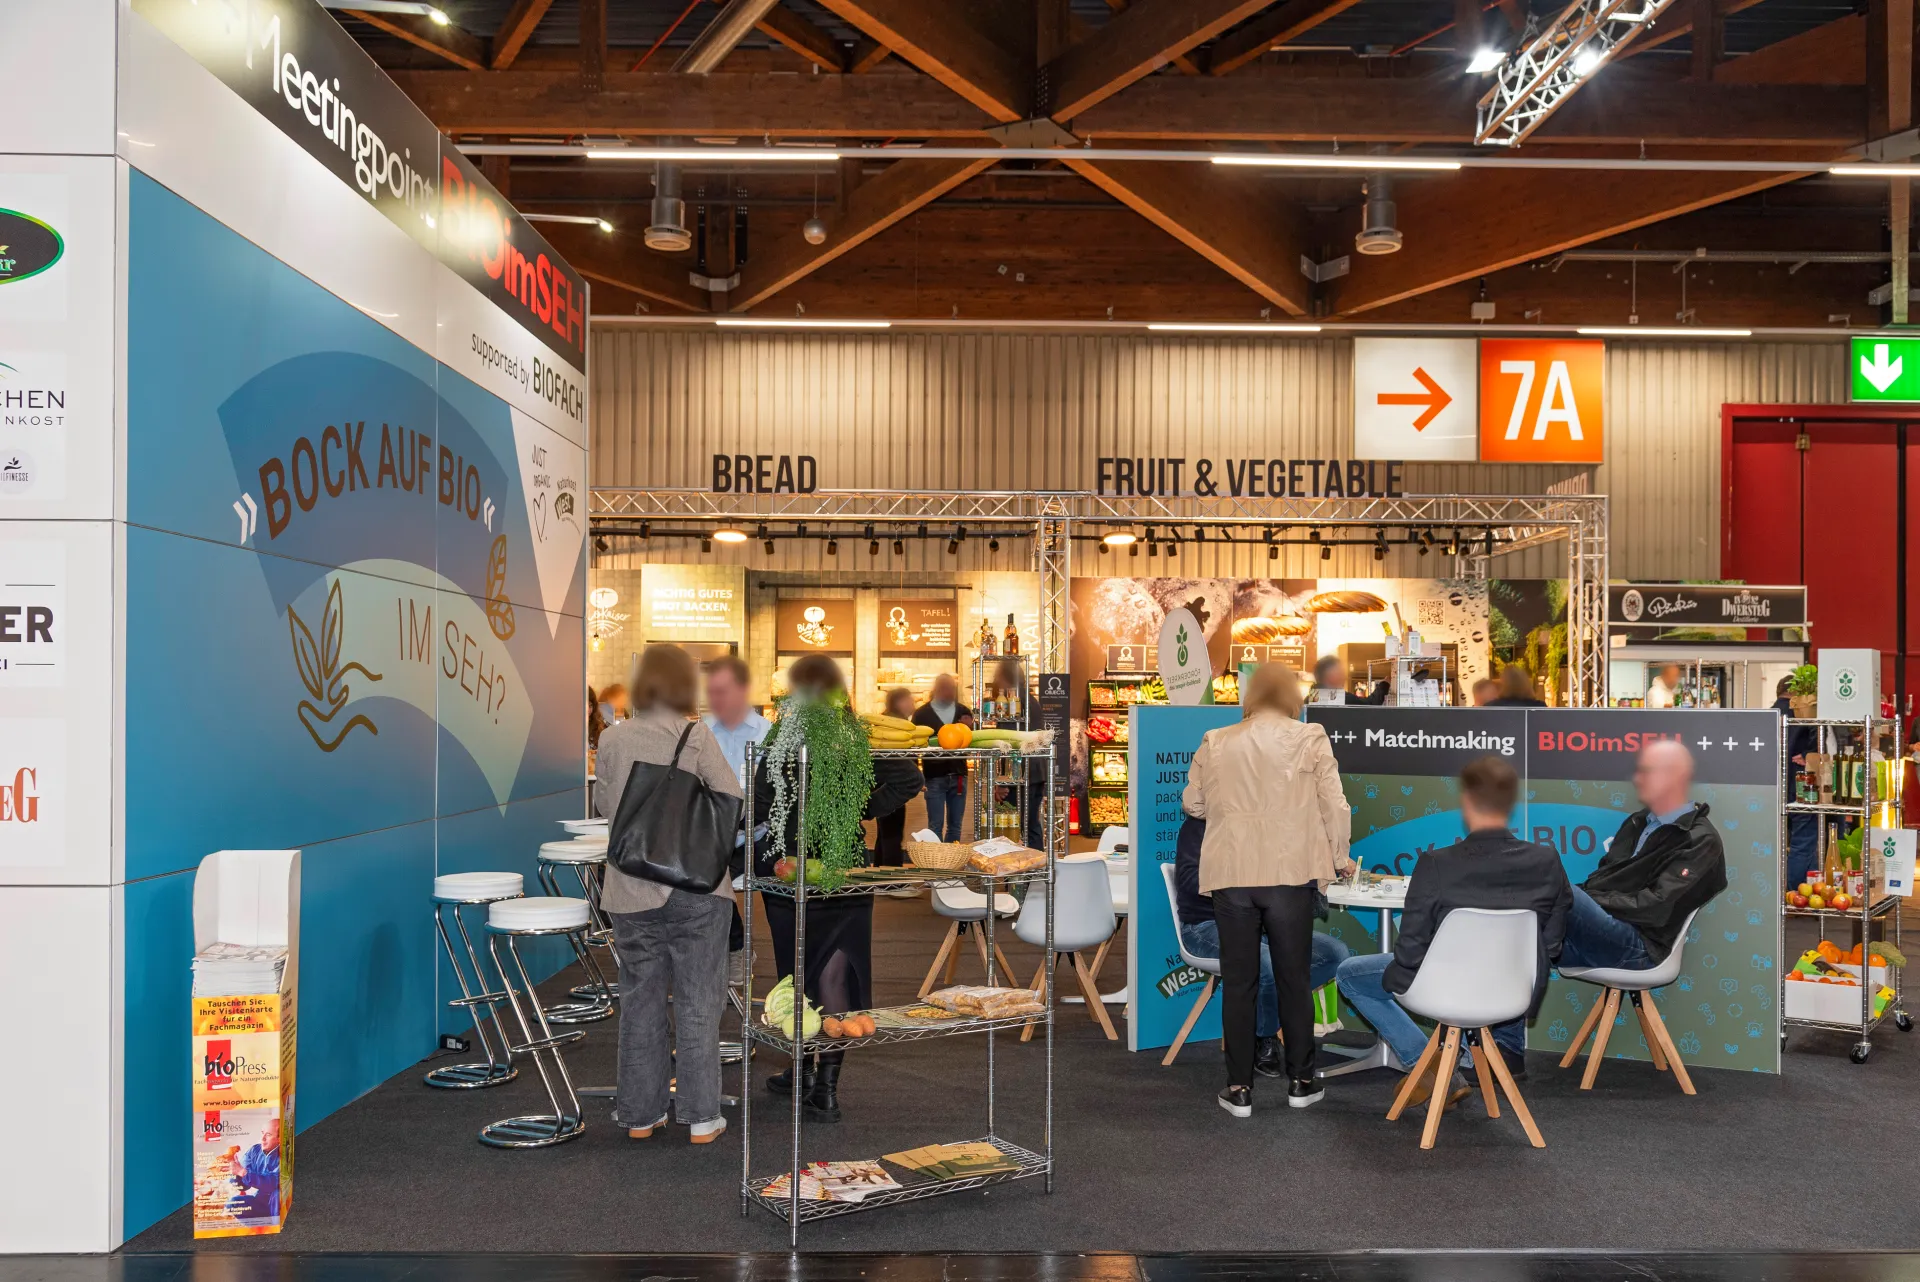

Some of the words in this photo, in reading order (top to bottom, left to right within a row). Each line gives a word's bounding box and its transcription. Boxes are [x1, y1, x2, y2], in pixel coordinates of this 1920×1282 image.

[246, 14, 435, 229] Meetingpoint
[443, 155, 584, 352] BIOimSEH
[471, 333, 518, 384] supported
[520, 364, 530, 393] by
[533, 356, 583, 424] BIOFACH
[0, 390, 64, 408] HEN
[1499, 360, 1584, 441] 7A
[532, 444, 547, 469] JUST
[258, 421, 370, 540] BOCK
[377, 422, 431, 495] AUF
[438, 443, 481, 521] BIO
[712, 454, 817, 493] BREAD
[1098, 457, 1185, 496] FRUIT
[1194, 458, 1218, 497] &
[1226, 458, 1403, 498] VEGETABLE
[698, 589, 733, 599] GUTES
[0, 606, 54, 643] ER
[398, 597, 431, 665] IM
[442, 620, 506, 725] SEH?
[1365, 727, 1515, 757] Matchmaking
[1156, 809, 1176, 822] und
[207, 999, 246, 1008] Tauschen
[249, 998, 266, 1006] Sie:
[219, 1006, 274, 1015] Visitenkarte
[209, 1022, 264, 1031] Fachmagazin
[237, 1014, 251, 1022] ein
[204, 1052, 267, 1078] bioPress
[203, 1097, 268, 1107] www.biopress.de
